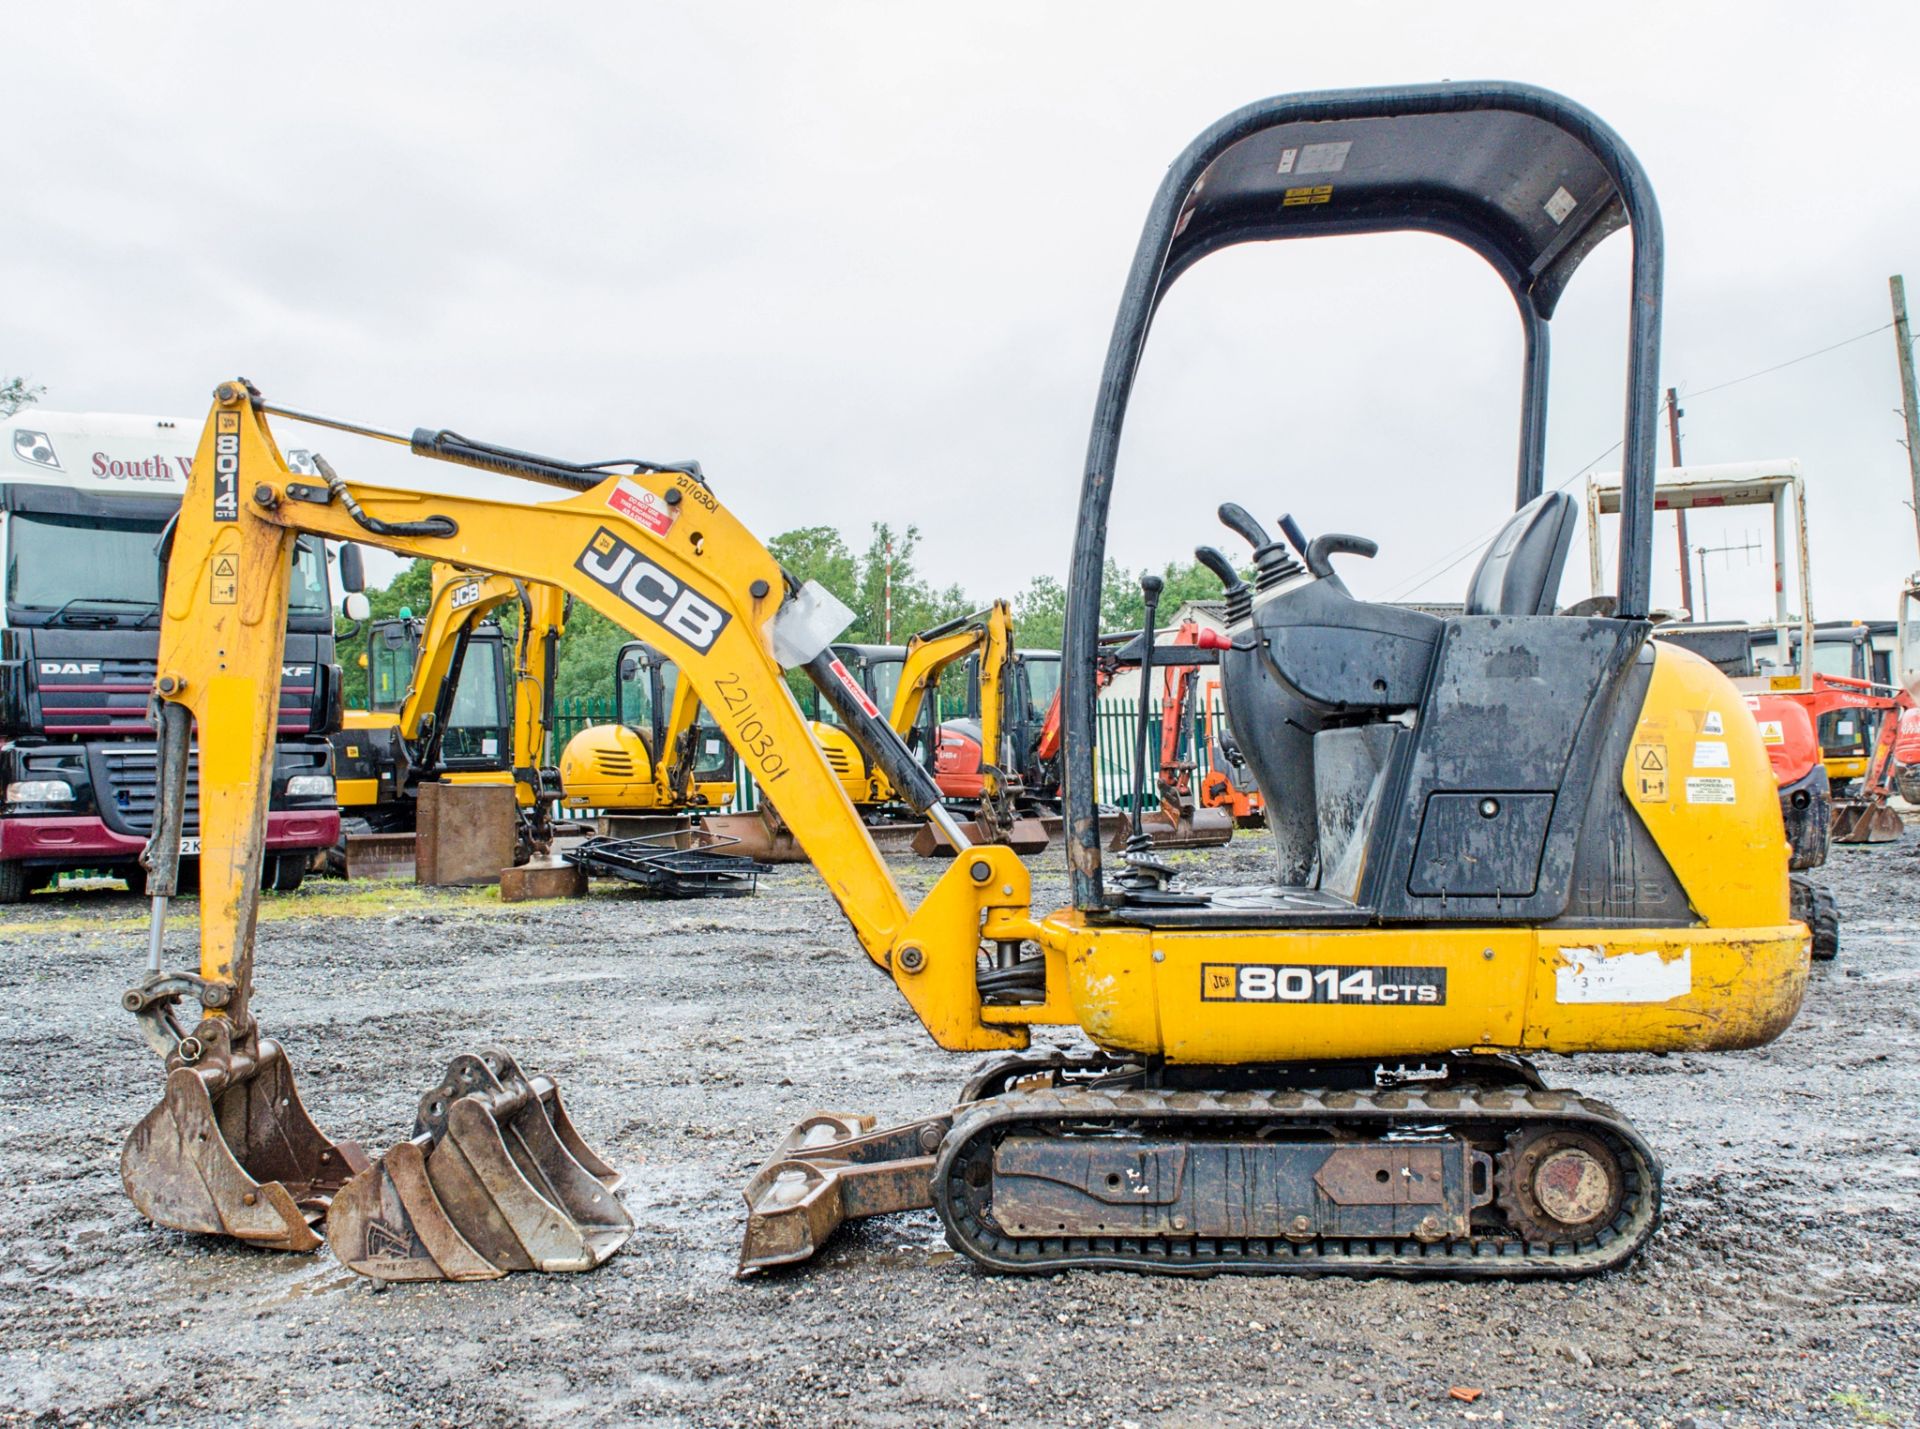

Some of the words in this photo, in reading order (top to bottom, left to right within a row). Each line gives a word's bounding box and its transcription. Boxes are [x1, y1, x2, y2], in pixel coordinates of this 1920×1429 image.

[92, 452, 175, 481] South
[215, 435, 238, 510] 8014
[452, 583, 480, 608] JCB
[582, 548, 722, 648] JCB
[41, 663, 100, 675] DAF
[281, 667, 312, 676] XF
[715, 672, 790, 782] 22110301
[1212, 974, 1231, 990] JCB
[1239, 967, 1377, 1001] 8014
